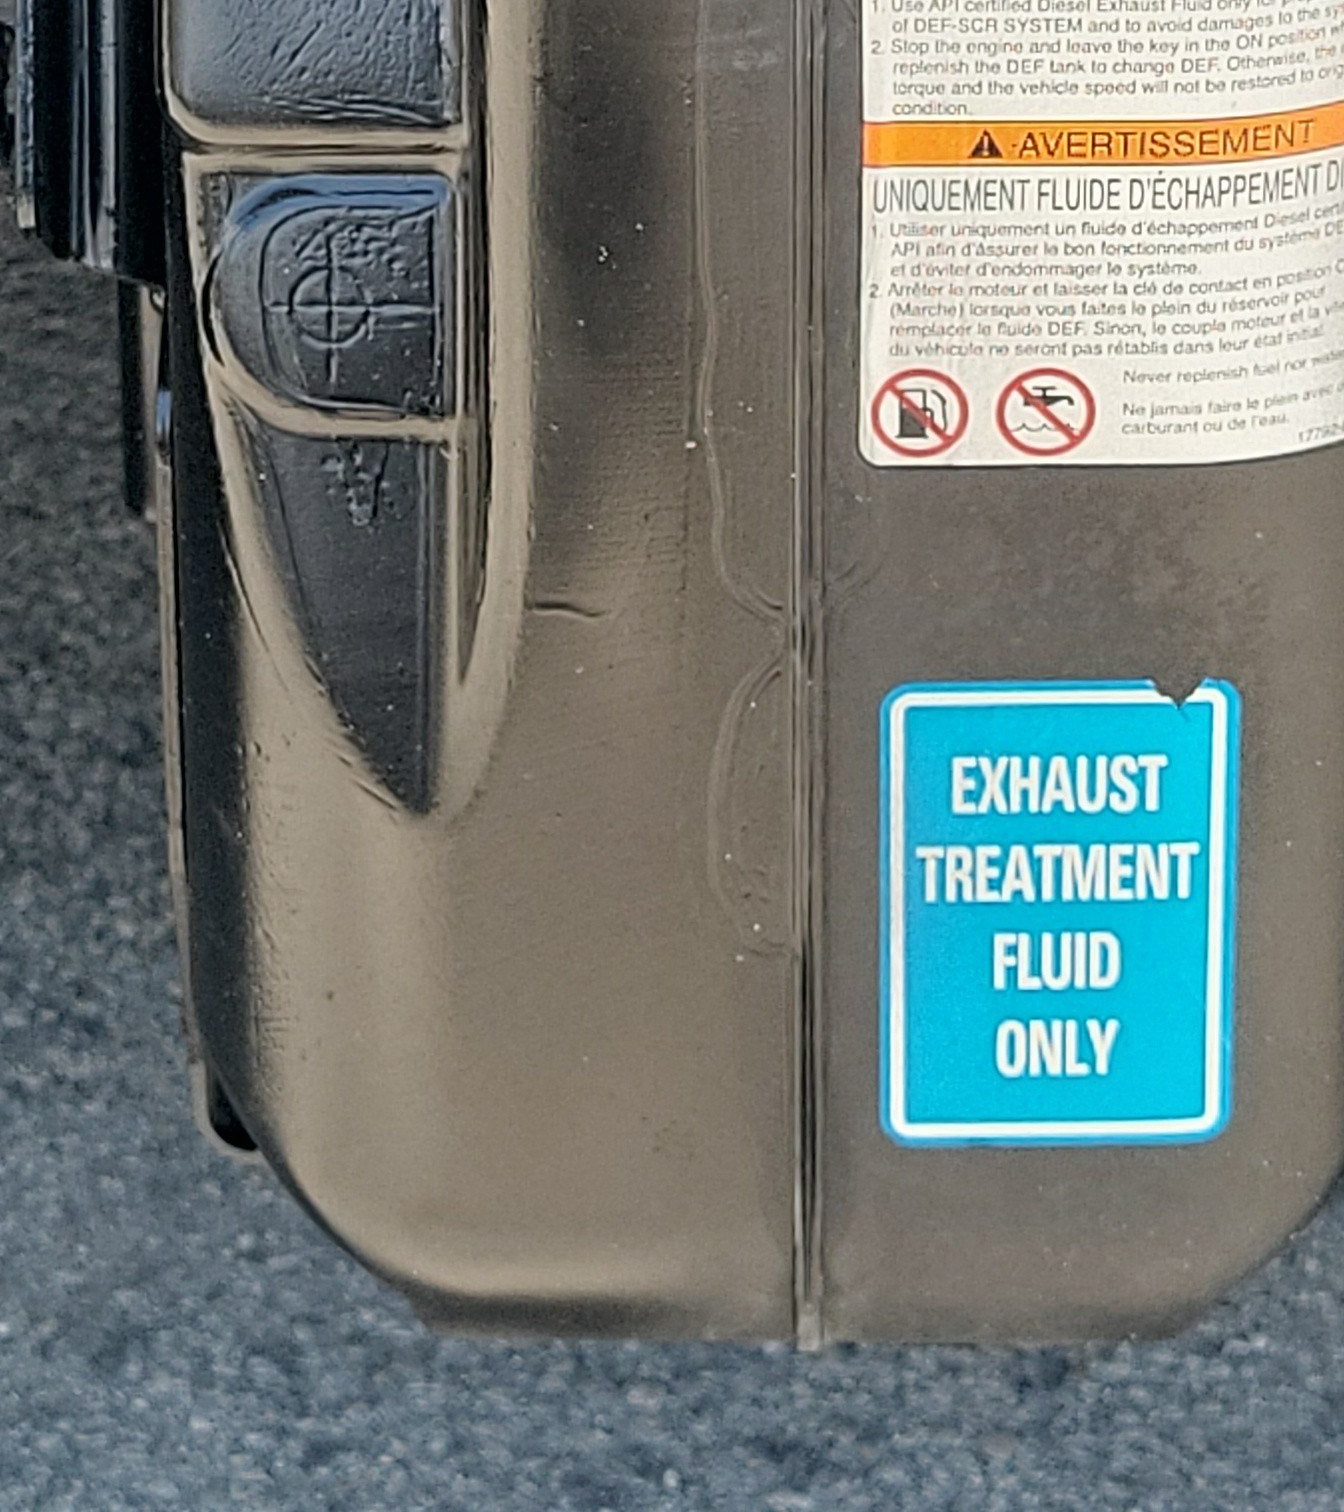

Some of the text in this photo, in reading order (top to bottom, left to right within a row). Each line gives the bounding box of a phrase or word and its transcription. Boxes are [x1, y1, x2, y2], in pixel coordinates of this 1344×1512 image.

[892, 18, 908, 34] of
[913, 18, 998, 34] DEF-SCR
[1003, 18, 1083, 34] SYSTEM
[1087, 18, 1120, 34] and
[1125, 18, 1141, 34] to
[1146, 17, 1192, 33] avoid
[1197, 14, 1273, 34] damages
[1278, 11, 1293, 26] to
[1297, 7, 1320, 22] the
[891, 39, 929, 57] Stop
[934, 39, 961, 54] the
[966, 39, 1023, 57] engine
[1028, 39, 1061, 54] and
[1066, 39, 1112, 54] leave
[1117, 38, 1144, 54] the
[1149, 37, 1179, 56] key
[1185, 37, 1199, 51] in
[1205, 35, 1230, 51] the
[1236, 32, 1263, 50] ON
[1267, 24, 1326, 49] position
[892, 59, 970, 76] replenish
[974, 59, 1001, 74] the
[1006, 59, 1045, 74] DEF
[1049, 59, 1086, 74] tank
[1091, 59, 1107, 74] to
[1111, 60, 1175, 77] change
[1180, 57, 1221, 74] DEF.
[892, 80, 946, 98] torque
[950, 80, 984, 96] and
[988, 80, 1014, 96] the
[1019, 80, 1079, 96] vehicle
[1084, 80, 1137, 98] speed
[1141, 79, 1169, 94] will
[1173, 79, 1200, 94] not
[1205, 78, 1227, 94] be
[1230, 70, 1297, 93] restored
[1300, 67, 1315, 83] to
[892, 102, 972, 116] condition.
[1018, 118, 1316, 159] AVERTISSEMENT
[873, 178, 1031, 213] UNIQUEMENT
[1037, 178, 1122, 212] FLUIDE
[1129, 162, 1322, 211] D'ÉCHAPPEMENT
[889, 222, 946, 237] Utiliser
[950, 222, 1050, 240] uniquement
[1054, 224, 1076, 237] un
[1081, 221, 1126, 236] fluide
[1131, 217, 1258, 237] d'échappement
[891, 241, 921, 257] API
[925, 241, 956, 257] afin
[1043, 241, 1057, 257] le
[1063, 241, 1095, 257] bon
[1100, 241, 1229, 257] fonctionnement
[1233, 238, 1254, 252] du
[890, 261, 1202, 279] et d'éviter d'endommager le système.
[887, 282, 944, 297] Arrêter
[948, 282, 964, 297] le
[968, 282, 1027, 297] moteur
[1032, 282, 1049, 297] et
[1053, 282, 1107, 297] laisser
[1112, 282, 1128, 296] la
[1133, 281, 1157, 296] clé
[1162, 281, 1184, 295] de
[1188, 278, 1248, 295] contact
[1252, 275, 1272, 289] en
[889, 302, 965, 319] (Marche)
[969, 302, 1031, 319] lorsque
[1035, 304, 1077, 316] vous
[1081, 301, 1127, 316] faites
[1131, 300, 1147, 316] le
[1151, 300, 1192, 319] plein
[1197, 299, 1218, 314] du
[1222, 293, 1289, 313] réservoir
[889, 321, 972, 338] remplacer
[976, 321, 991, 336] le
[997, 320, 1043, 336] fluide
[1093, 321, 1147, 338] Sinon,
[1152, 321, 1167, 336] le
[1171, 319, 1227, 338] couple
[1231, 314, 1286, 332] moteur
[888, 342, 909, 357] du
[914, 341, 984, 357] véhicule
[988, 344, 1009, 357] ne
[1014, 341, 1067, 357] seront
[1071, 343, 1103, 359] pas
[1107, 339, 1169, 356] rétablis
[1173, 338, 1214, 354] dans
[1218, 335, 1248, 353] leur
[1123, 368, 1171, 384] Never
[1176, 366, 1249, 384] replenish
[1122, 402, 1146, 416] Ne
[1150, 402, 1203, 418] jamais
[1207, 400, 1242, 415] faire
[1121, 420, 1199, 436] carburant
[1203, 422, 1223, 434] ou
[1227, 415, 1247, 430] de
[951, 754, 1169, 815] EXHAUST
[915, 841, 1201, 903] TREATMENT
[992, 931, 1122, 991] FLUID
[995, 1017, 1121, 1078] ONLY
